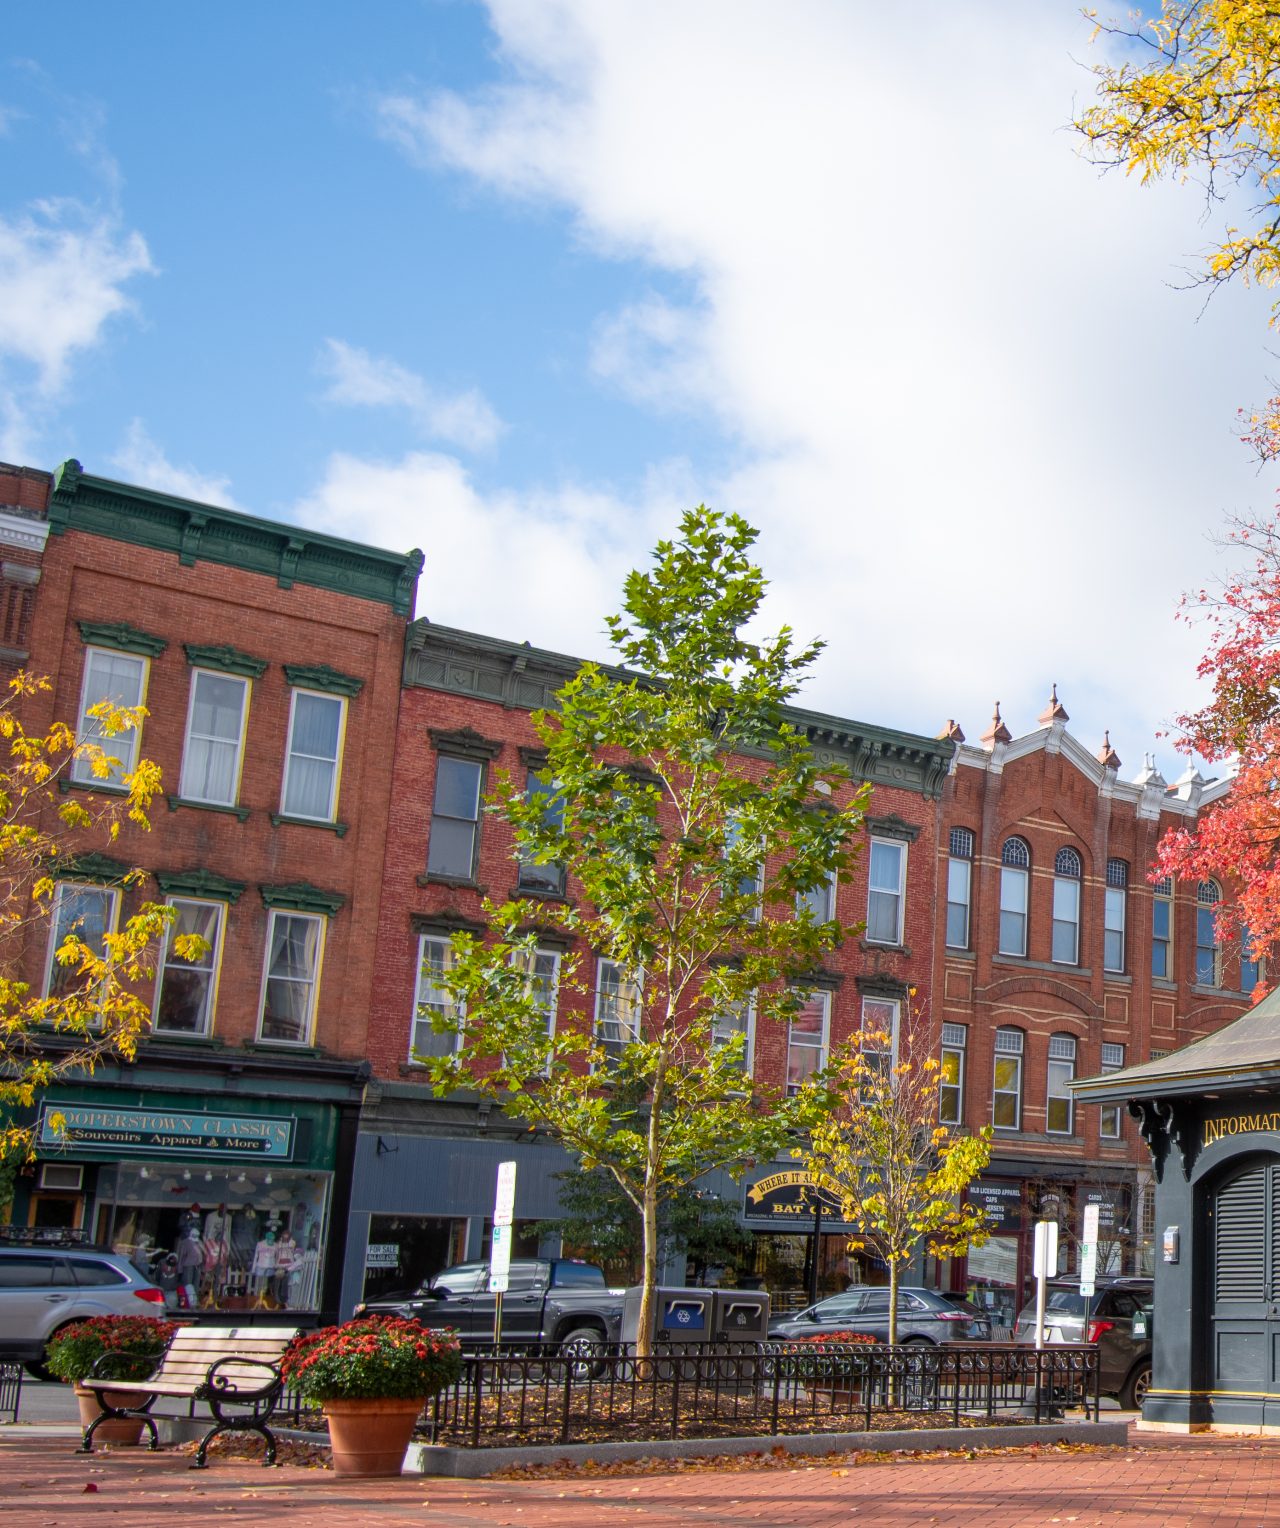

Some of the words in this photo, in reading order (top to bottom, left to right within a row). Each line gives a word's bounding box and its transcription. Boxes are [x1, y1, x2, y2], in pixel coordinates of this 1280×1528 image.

[48, 1111, 193, 1131] OOPERSTOWN
[203, 1120, 286, 1142] CLASSICS
[74, 1129, 141, 1141] Souvenirs
[150, 1133, 202, 1146] Apparel
[226, 1138, 259, 1149] More
[757, 1172, 788, 1193] WHERE
[791, 1173, 800, 1183] IT
[980, 1187, 1001, 1195] LICENSED
[1001, 1189, 1021, 1197] APPAREL
[772, 1204, 803, 1214] BAT
[985, 1204, 1005, 1212] JERSEYS
[369, 1245, 381, 1253] FOR
[382, 1245, 397, 1253] SALE
